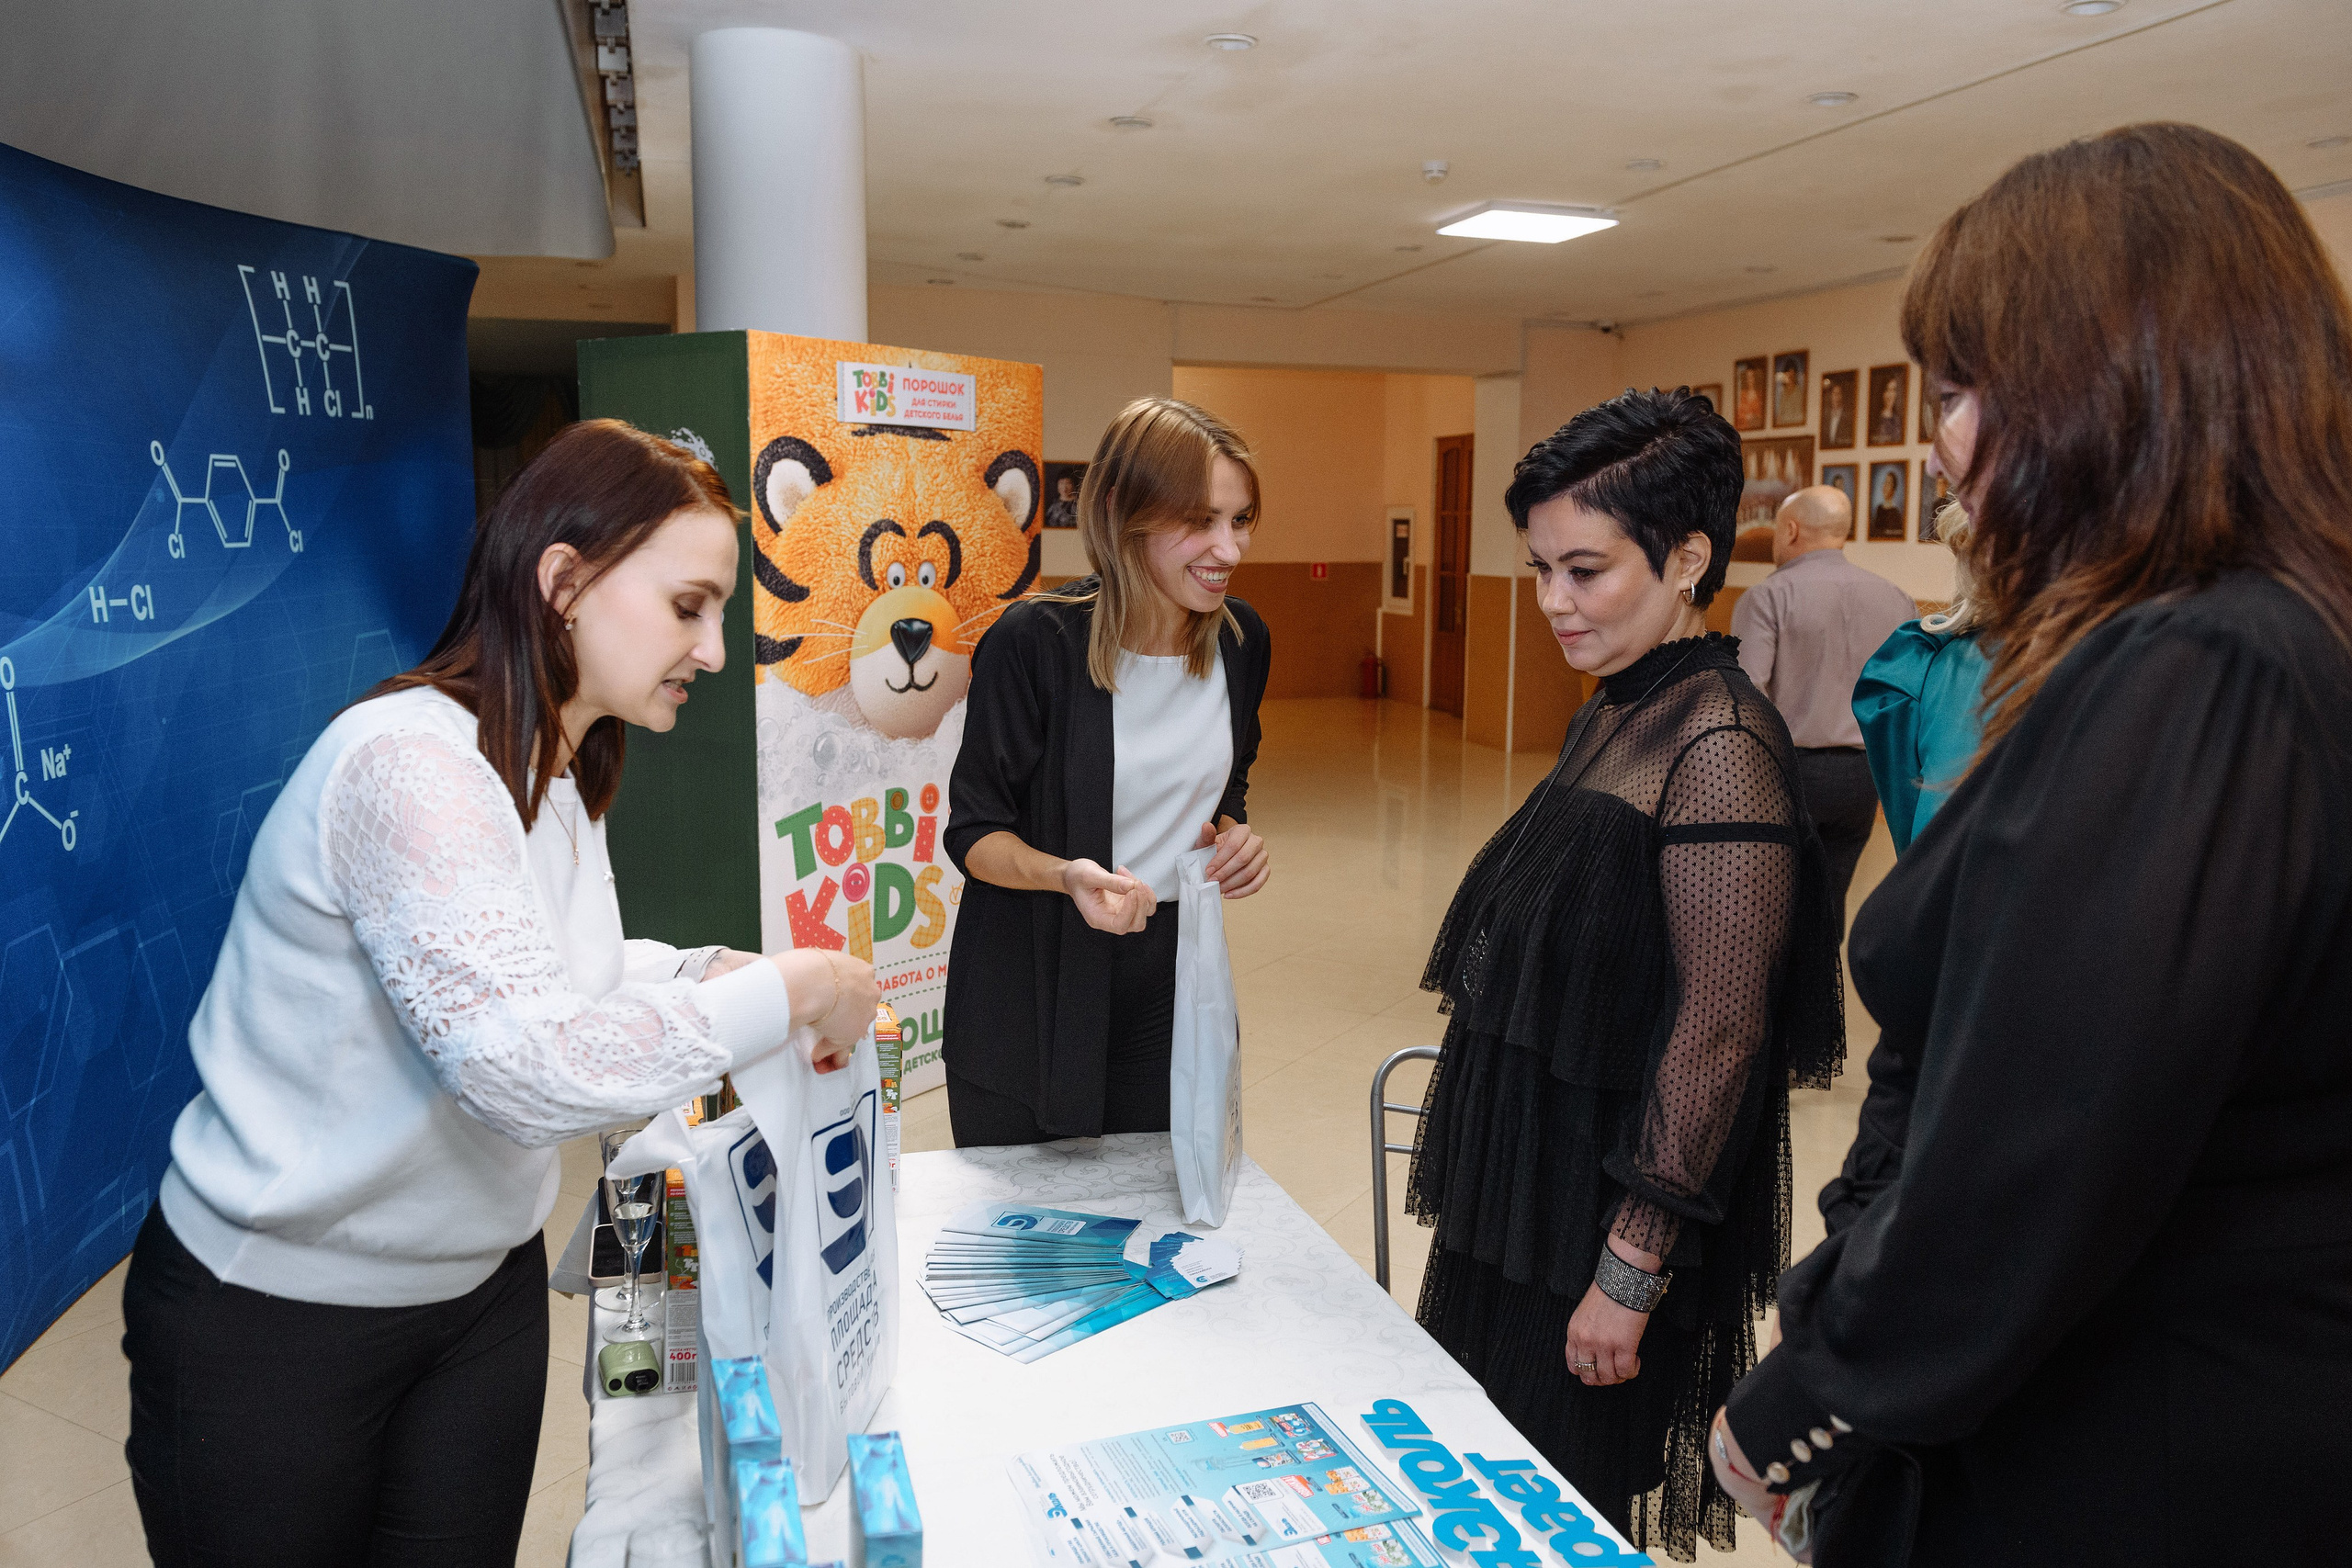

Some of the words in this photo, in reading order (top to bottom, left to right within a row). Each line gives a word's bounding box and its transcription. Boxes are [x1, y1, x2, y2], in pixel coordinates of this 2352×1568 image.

[269, 271, 290, 300] H
[303, 276, 321, 304] H
[902, 378, 965, 395] ПОРОШОК
[911, 398, 925, 406] ДЛЯ
[927, 400, 956, 408] СТИРКИ
[904, 410, 941, 420] ДЕТСКОГО
[943, 412, 963, 421] БЕЛЬЯ
[926, 966, 935, 980] О
[831, 1270, 877, 1352] ПЛОЩАДА
[837, 1301, 879, 1390] СРЕДСВ
[669, 1351, 697, 1360] 400г
